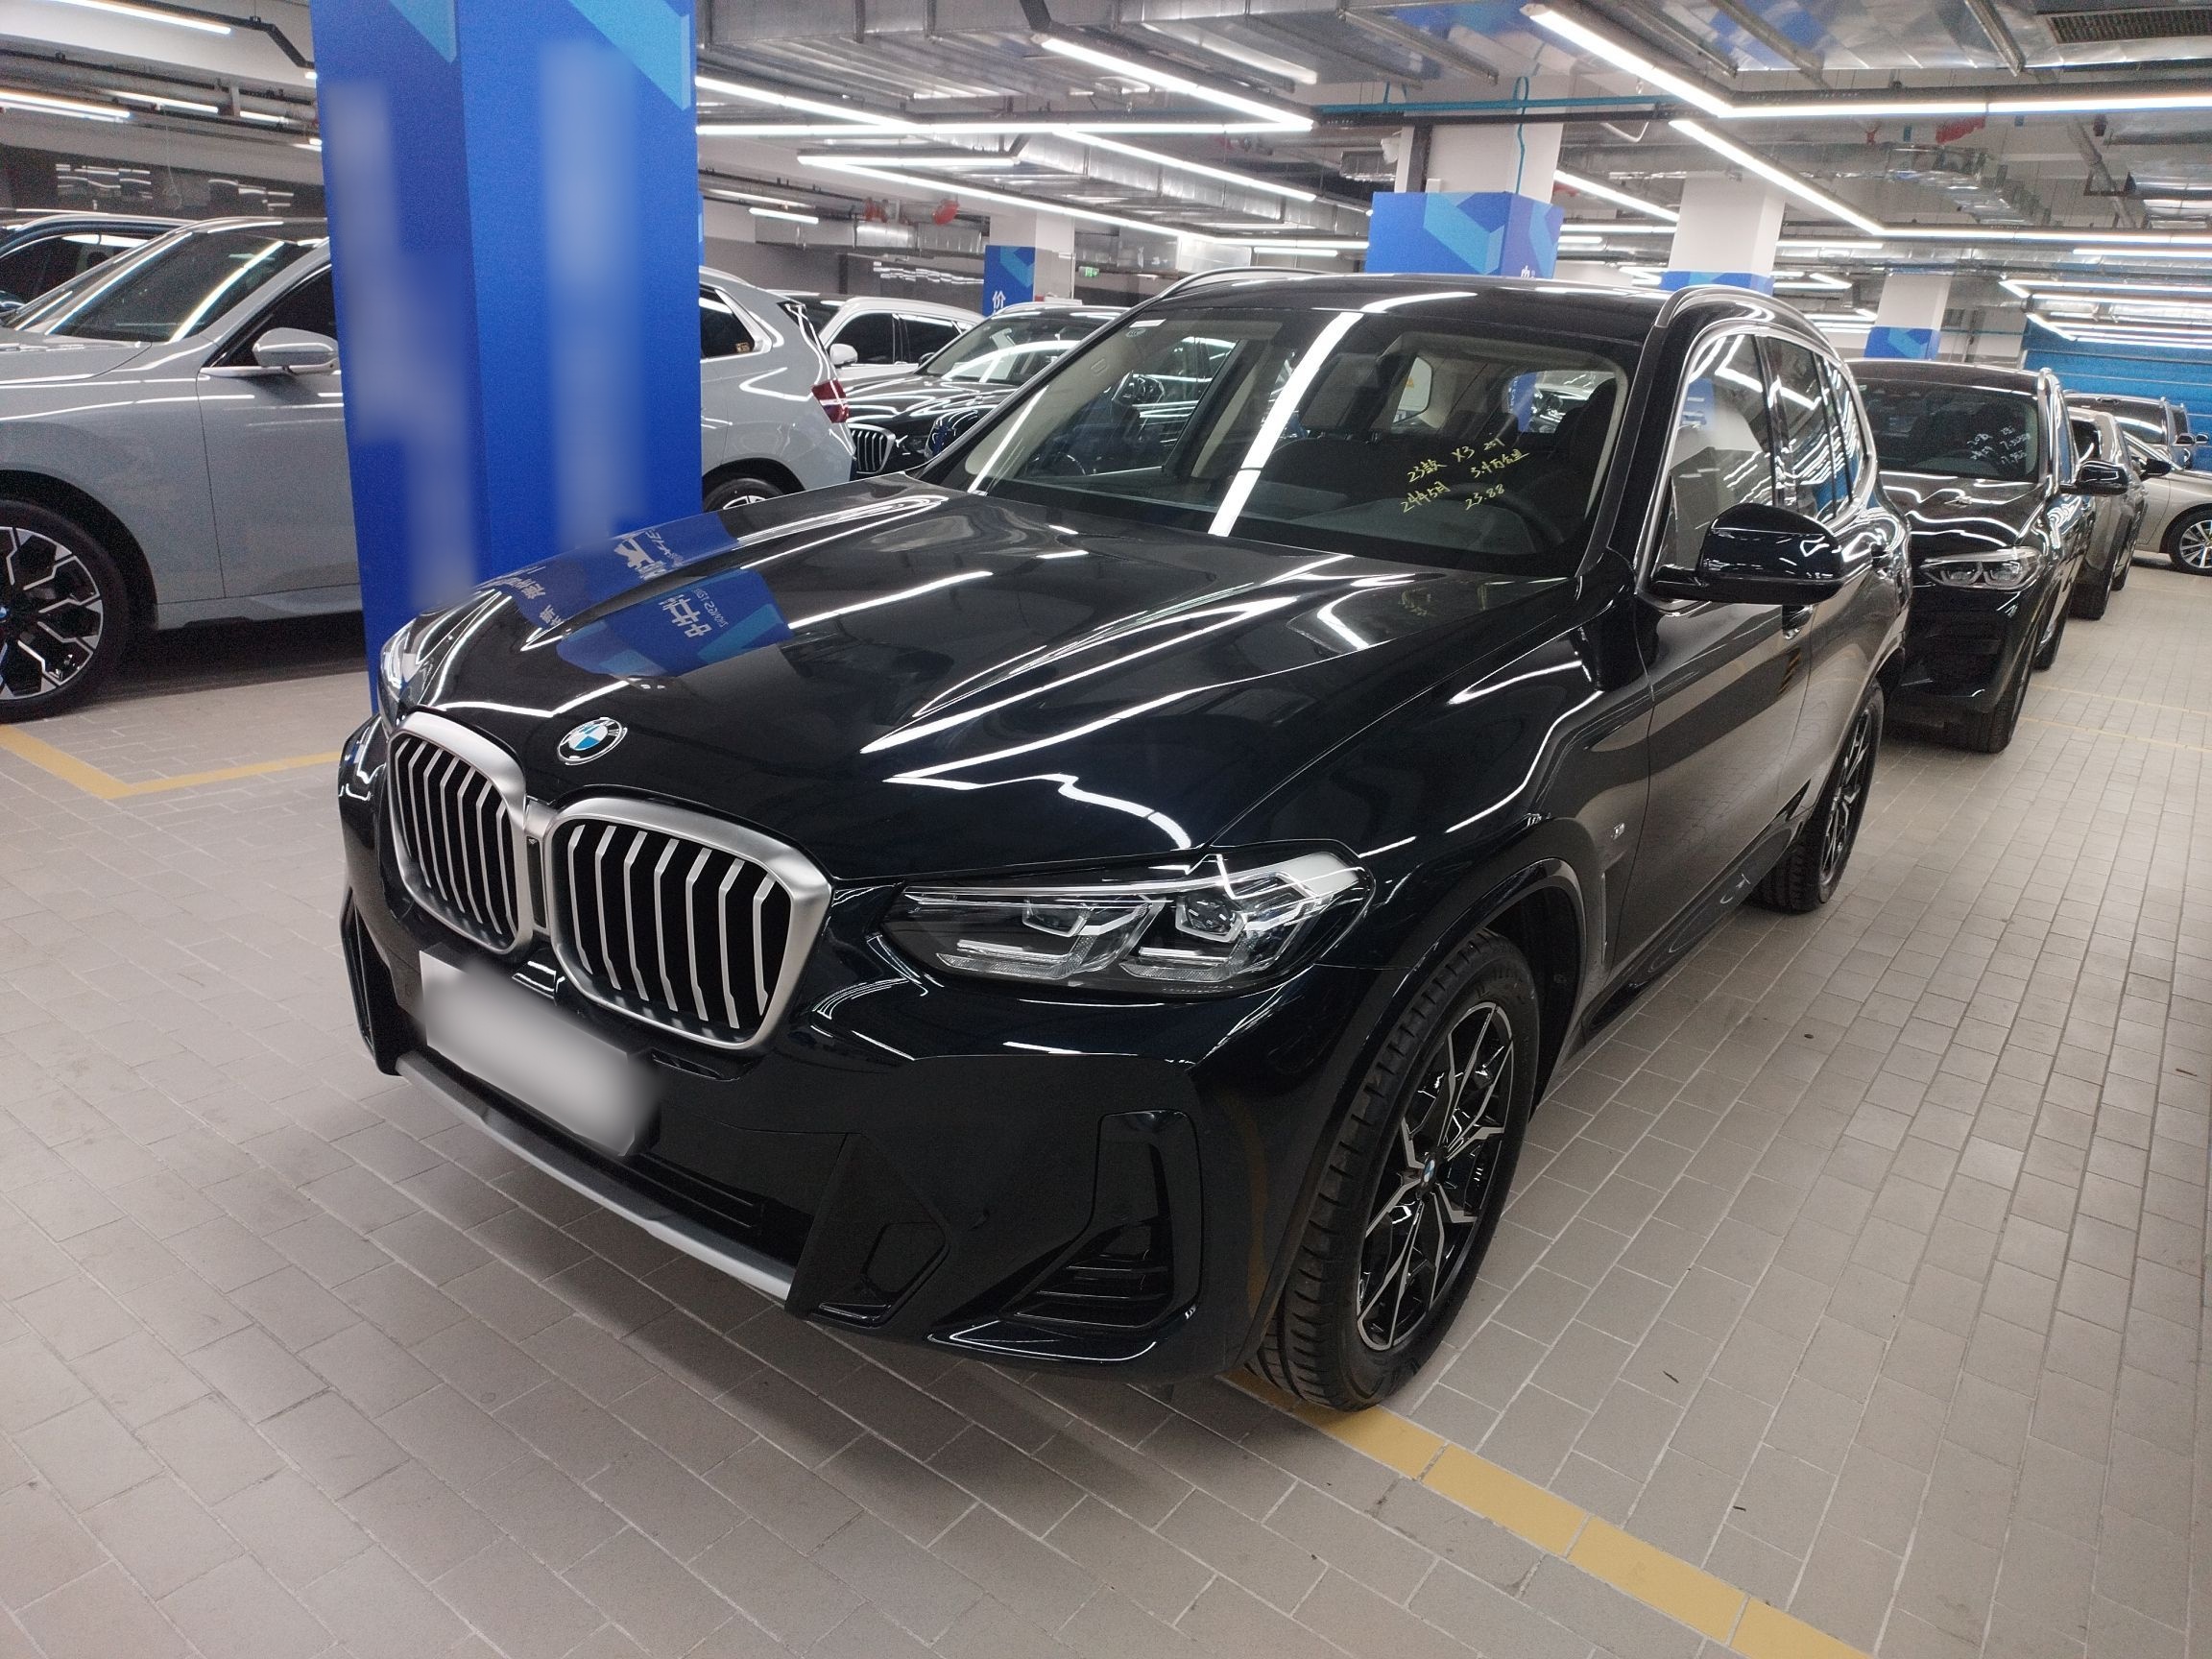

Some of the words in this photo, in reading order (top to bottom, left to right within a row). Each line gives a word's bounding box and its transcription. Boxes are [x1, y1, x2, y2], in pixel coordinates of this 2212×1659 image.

[1407, 459, 1448, 483] 23款
[1452, 445, 1475, 463] X3
[1400, 481, 1451, 513] 24年5月
[1465, 483, 1505, 511] 23.88
